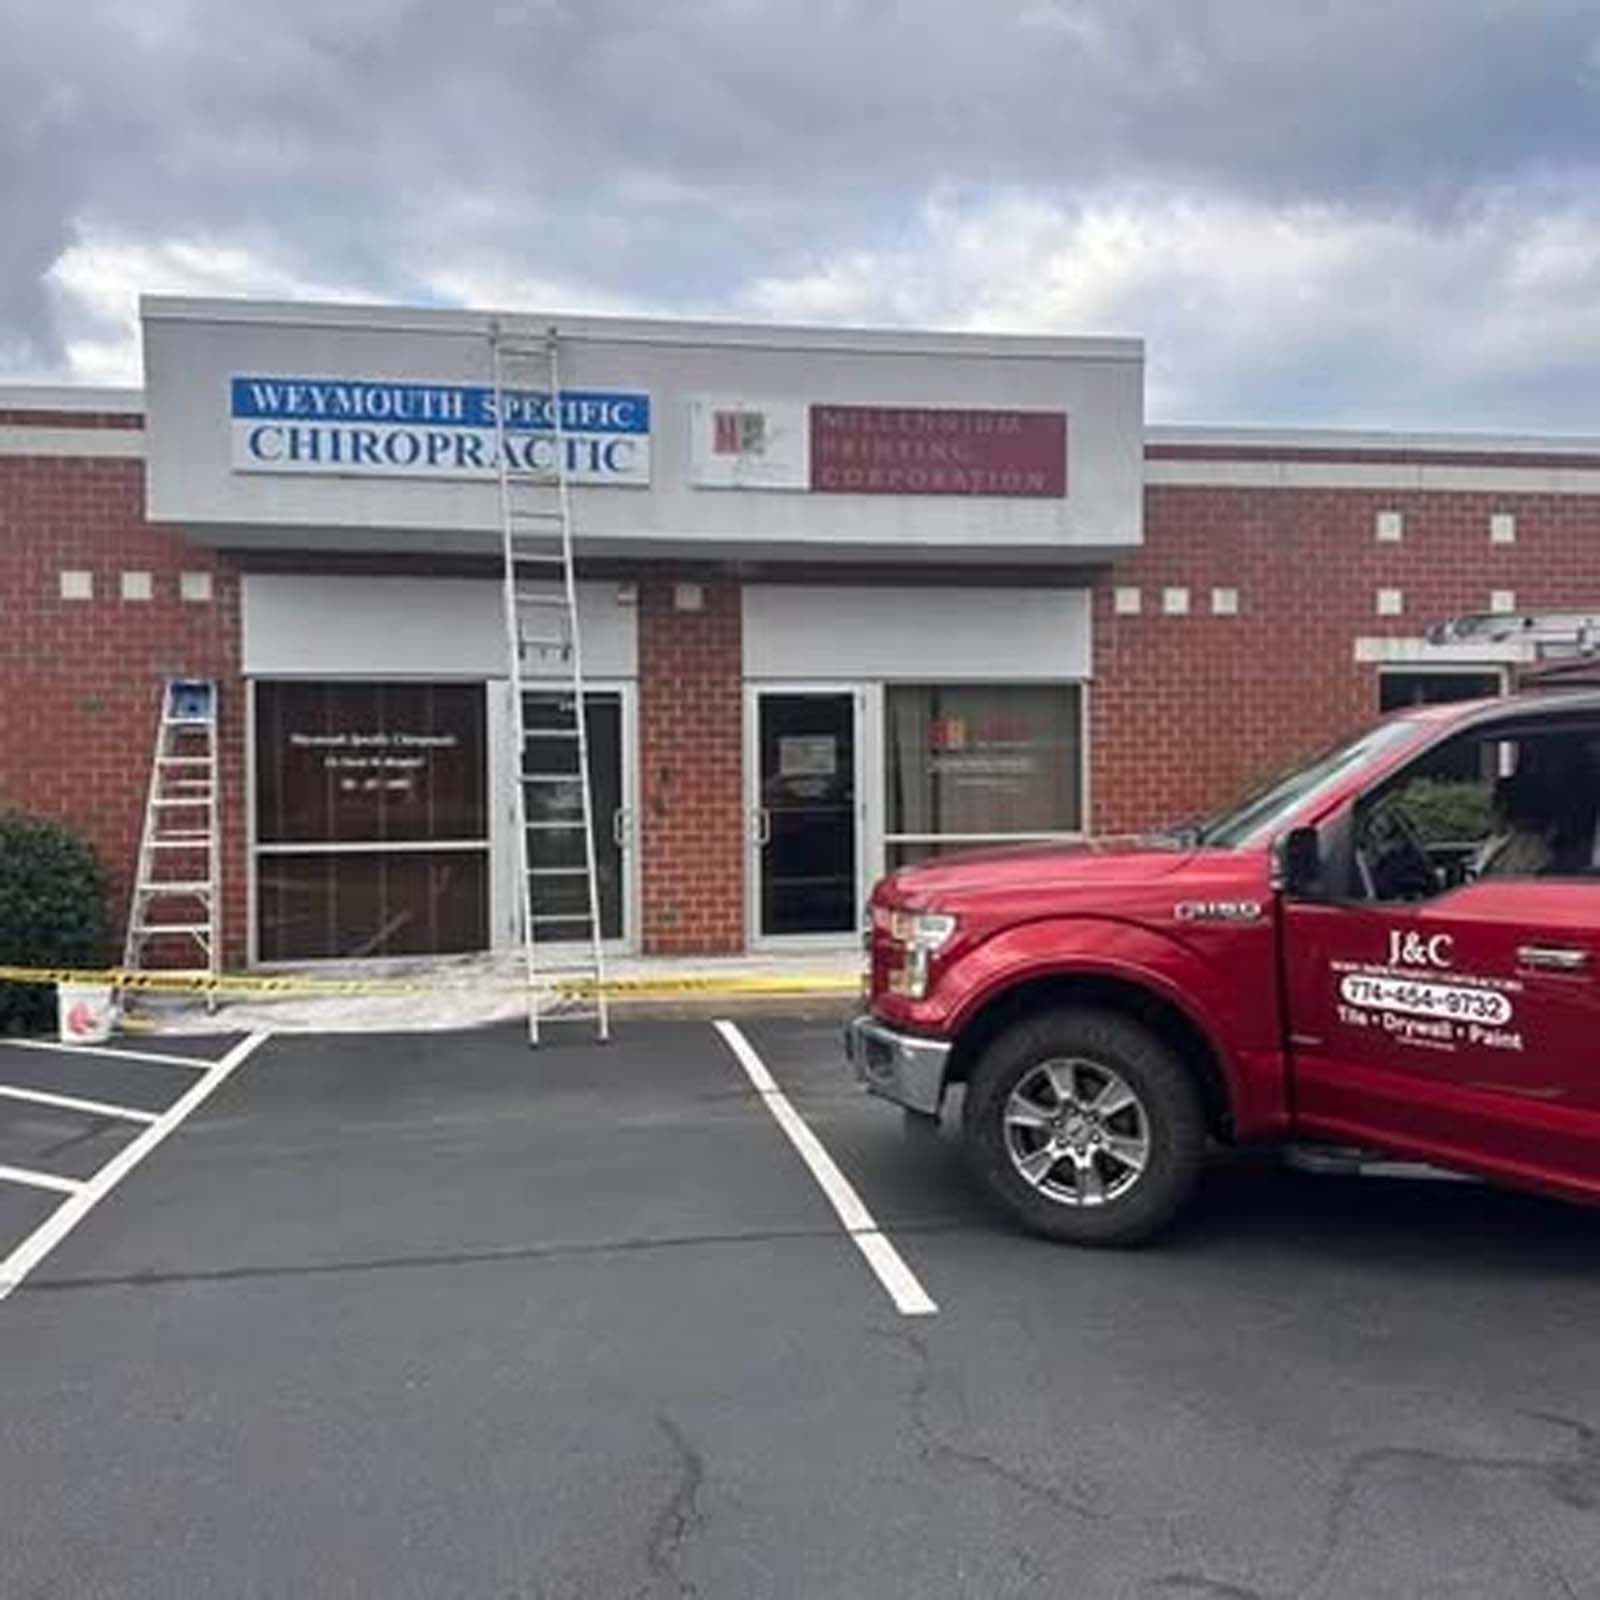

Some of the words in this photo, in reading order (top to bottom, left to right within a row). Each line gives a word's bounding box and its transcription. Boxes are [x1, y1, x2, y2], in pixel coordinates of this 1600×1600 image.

[251, 382, 464, 420] WEYMOUTH
[481, 397, 635, 427] SPECIFIC
[248, 425, 636, 474] CHIROPRACTIC
[821, 465, 1047, 491] CORPORATION
[1389, 929, 1454, 967] J&C
[1382, 1011, 1454, 1039] Drywall
[1468, 1024, 1524, 1051] Paint
